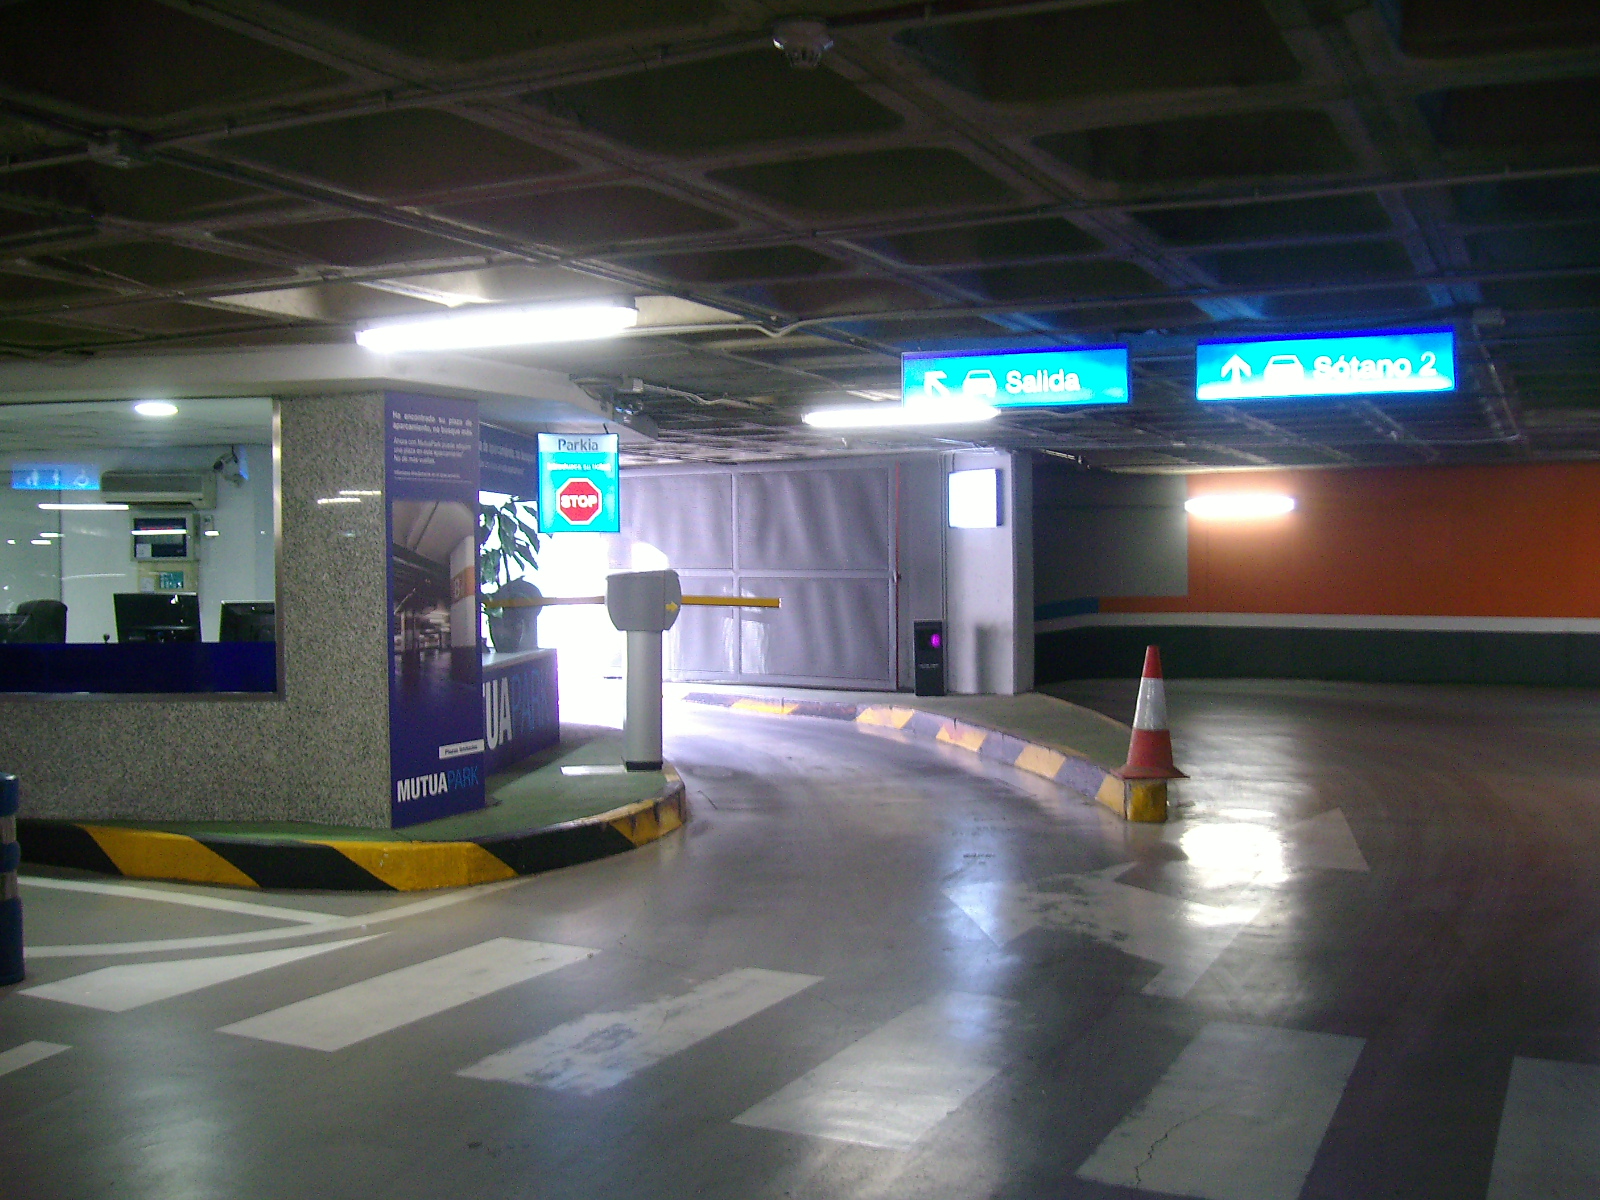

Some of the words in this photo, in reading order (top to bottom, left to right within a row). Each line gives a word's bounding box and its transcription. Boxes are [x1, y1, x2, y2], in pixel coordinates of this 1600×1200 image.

[1313, 353, 1412, 381] Sótano
[1419, 351, 1437, 377] 2
[1005, 368, 1081, 394] Salida
[558, 438, 599, 451] Parkia
[561, 494, 598, 508] STOP
[397, 766, 478, 802] MUTUAPARK
